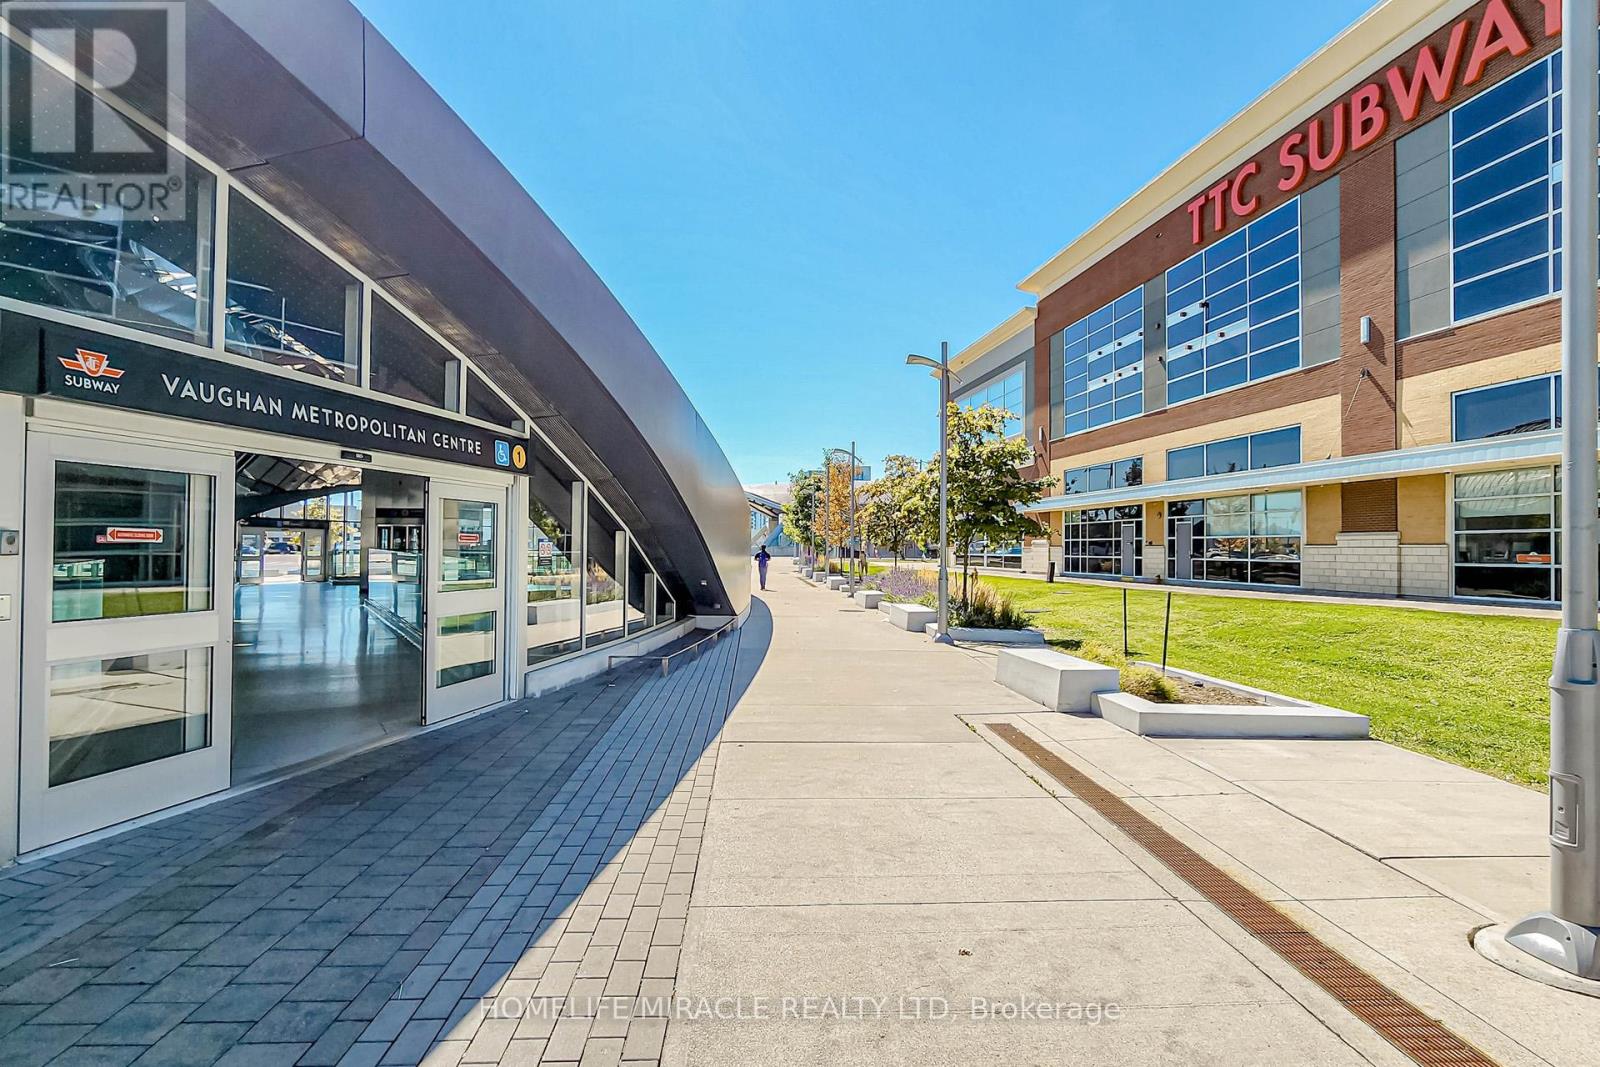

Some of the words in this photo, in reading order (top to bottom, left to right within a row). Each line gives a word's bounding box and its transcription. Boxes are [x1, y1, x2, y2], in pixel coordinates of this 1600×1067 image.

[1187, 162, 1259, 245] TTC
[64, 374, 120, 394] SUBWAY
[161, 373, 282, 417] VAUGHAN
[291, 402, 426, 444] METROPOLITAN
[432, 432, 482, 455] CENTRE
